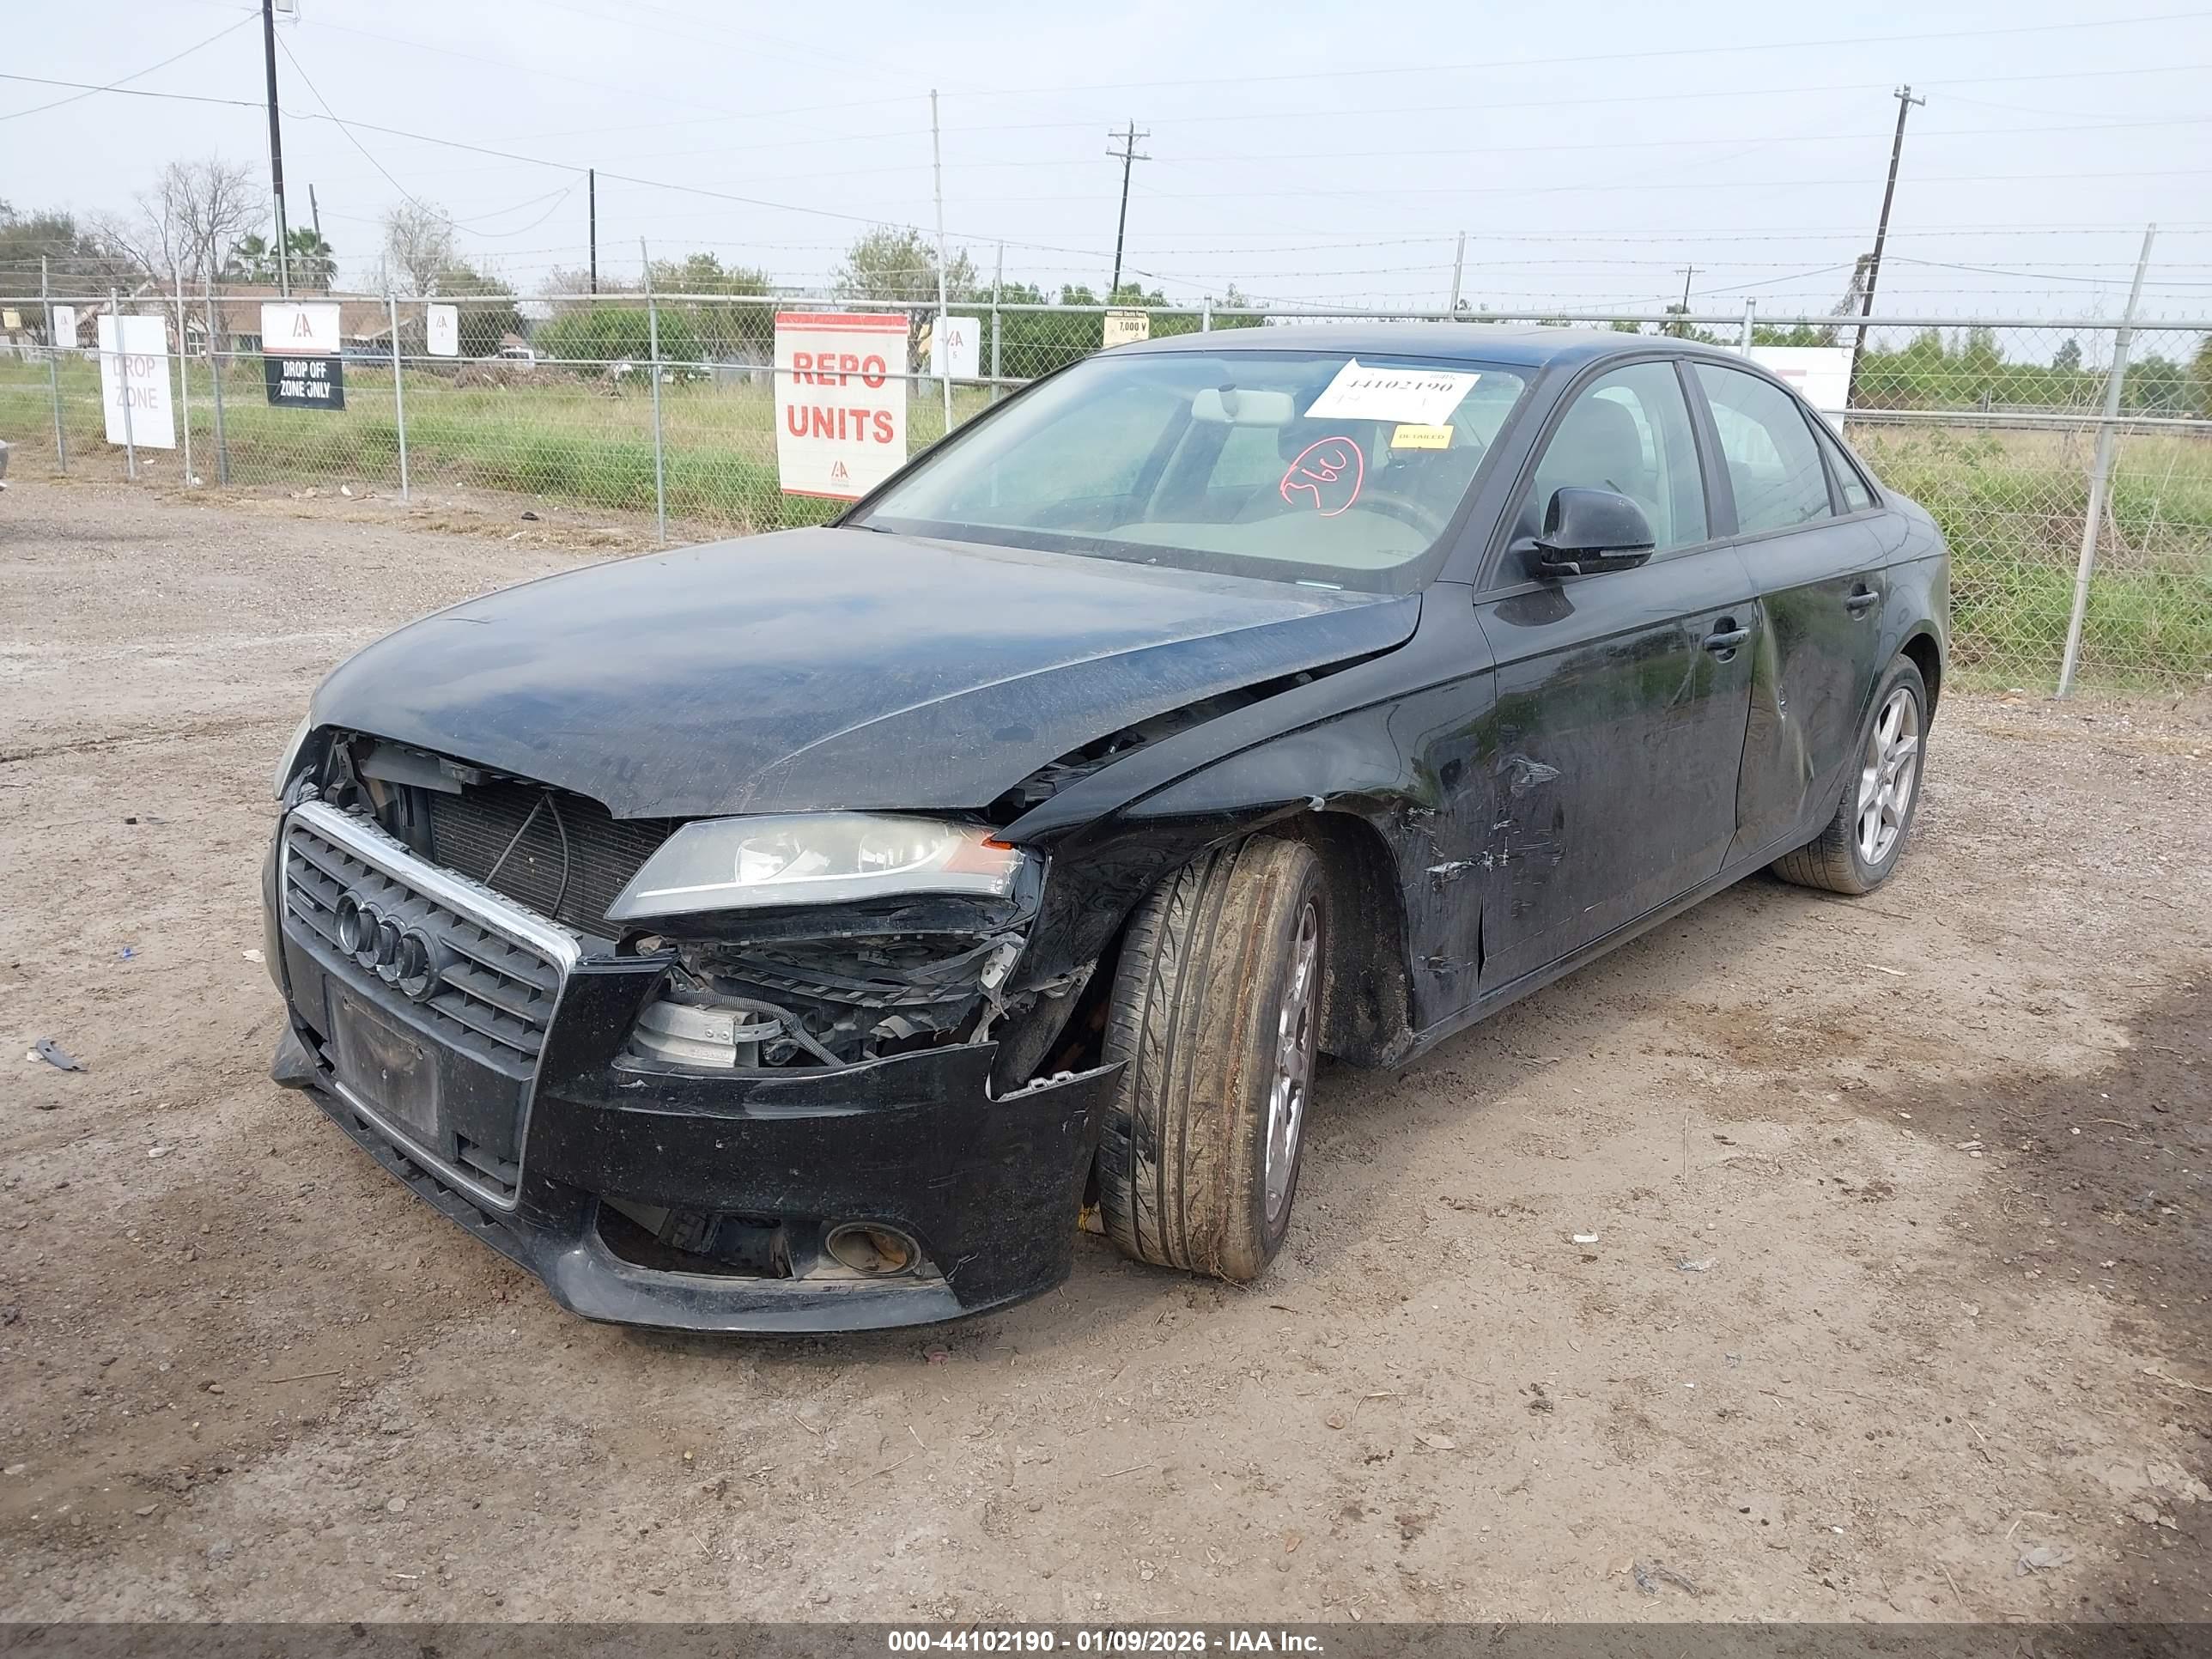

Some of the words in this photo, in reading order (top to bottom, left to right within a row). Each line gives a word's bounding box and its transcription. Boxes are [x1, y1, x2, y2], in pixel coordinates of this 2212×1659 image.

[1120, 322, 1139, 332] 7,000
[1141, 322, 1146, 332] V
[283, 362, 307, 378] DROP
[310, 362, 326, 378] OFF
[793, 352, 886, 388] REPO
[280, 380, 305, 397] ZONE
[307, 382, 330, 398] ONLY
[1346, 380, 1453, 392] 44102190
[116, 386, 158, 409] ZONE
[787, 404, 894, 444] UNITS
